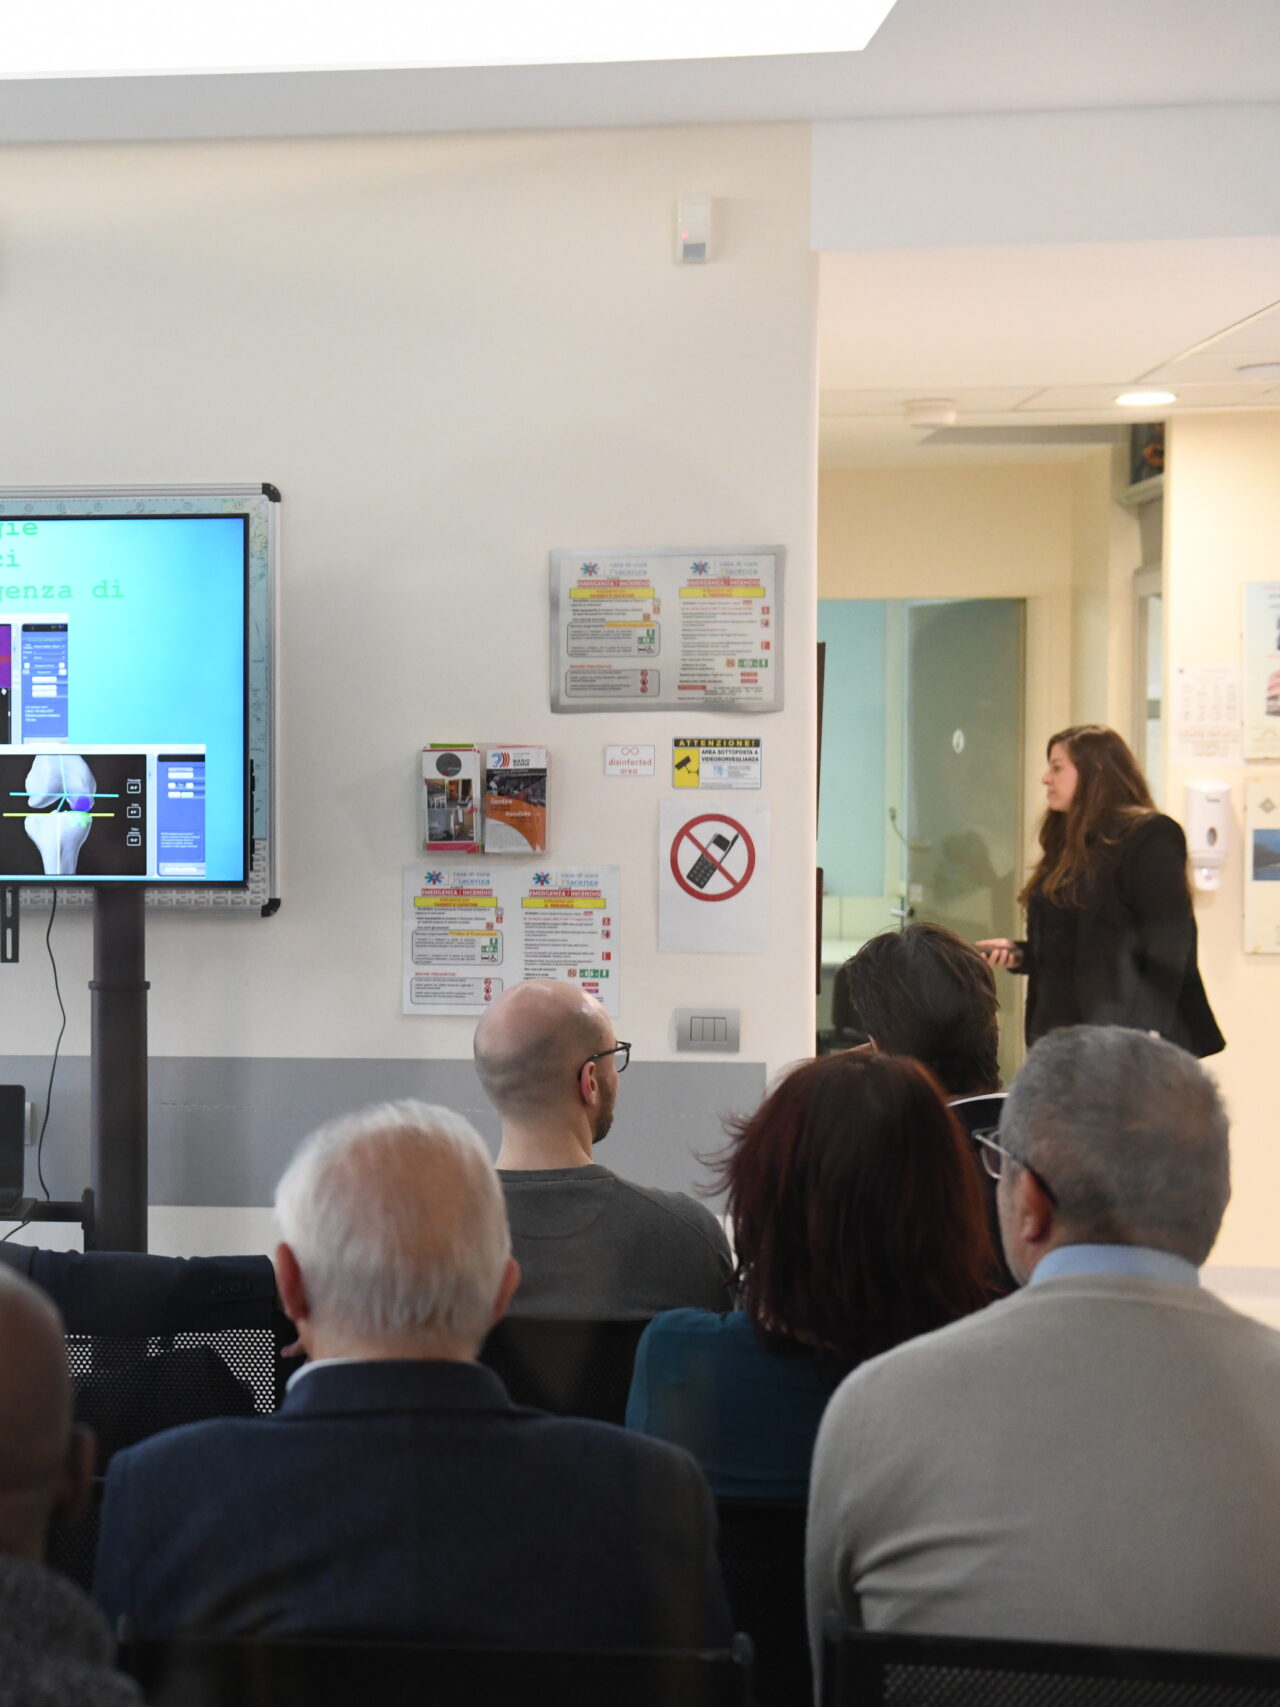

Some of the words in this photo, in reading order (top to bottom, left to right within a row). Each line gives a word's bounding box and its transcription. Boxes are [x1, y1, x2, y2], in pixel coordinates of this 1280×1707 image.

[92, 579, 124, 599] di
[679, 739, 755, 747] ATTENZIONE!
[608, 758, 652, 766] disinfected
